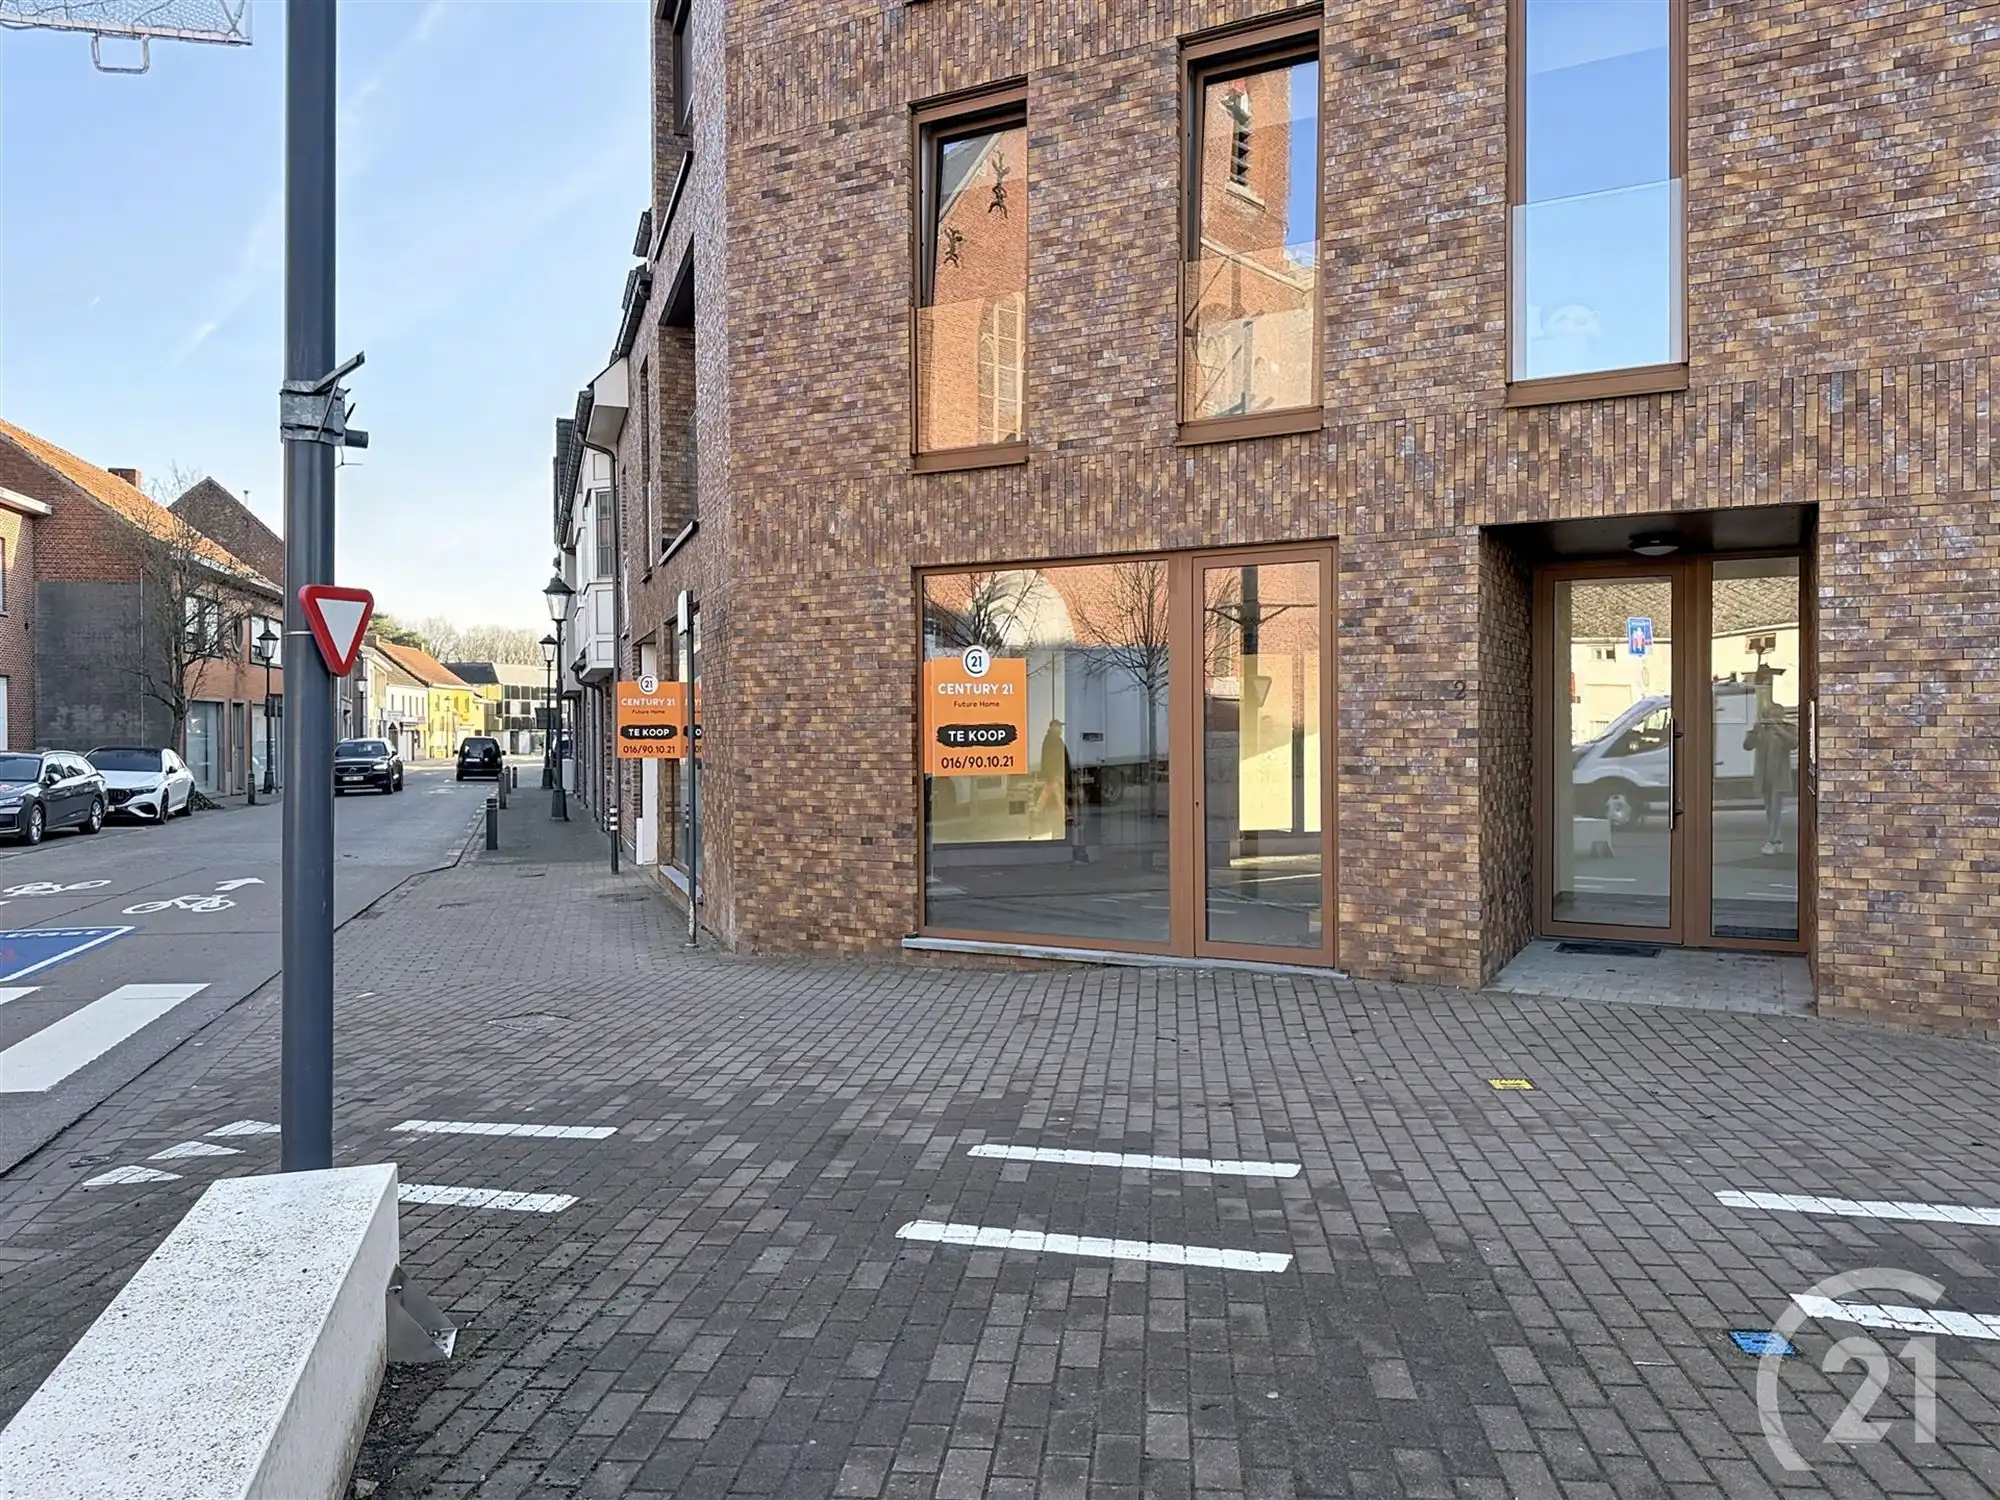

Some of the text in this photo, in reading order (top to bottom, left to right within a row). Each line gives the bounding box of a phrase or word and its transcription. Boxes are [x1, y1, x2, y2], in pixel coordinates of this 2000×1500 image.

[938, 683, 1014, 695] CENTURY 21
[1453, 680, 1466, 700] 2
[621, 698, 664, 706] CENTURY
[666, 698, 675, 706] 21
[953, 700, 977, 708] Future
[628, 728, 670, 736] TE KOOP
[948, 730, 1006, 742] TE KOOP
[622, 745, 676, 754] 016/90.10.21
[941, 756, 1014, 769] 016/90.10.21
